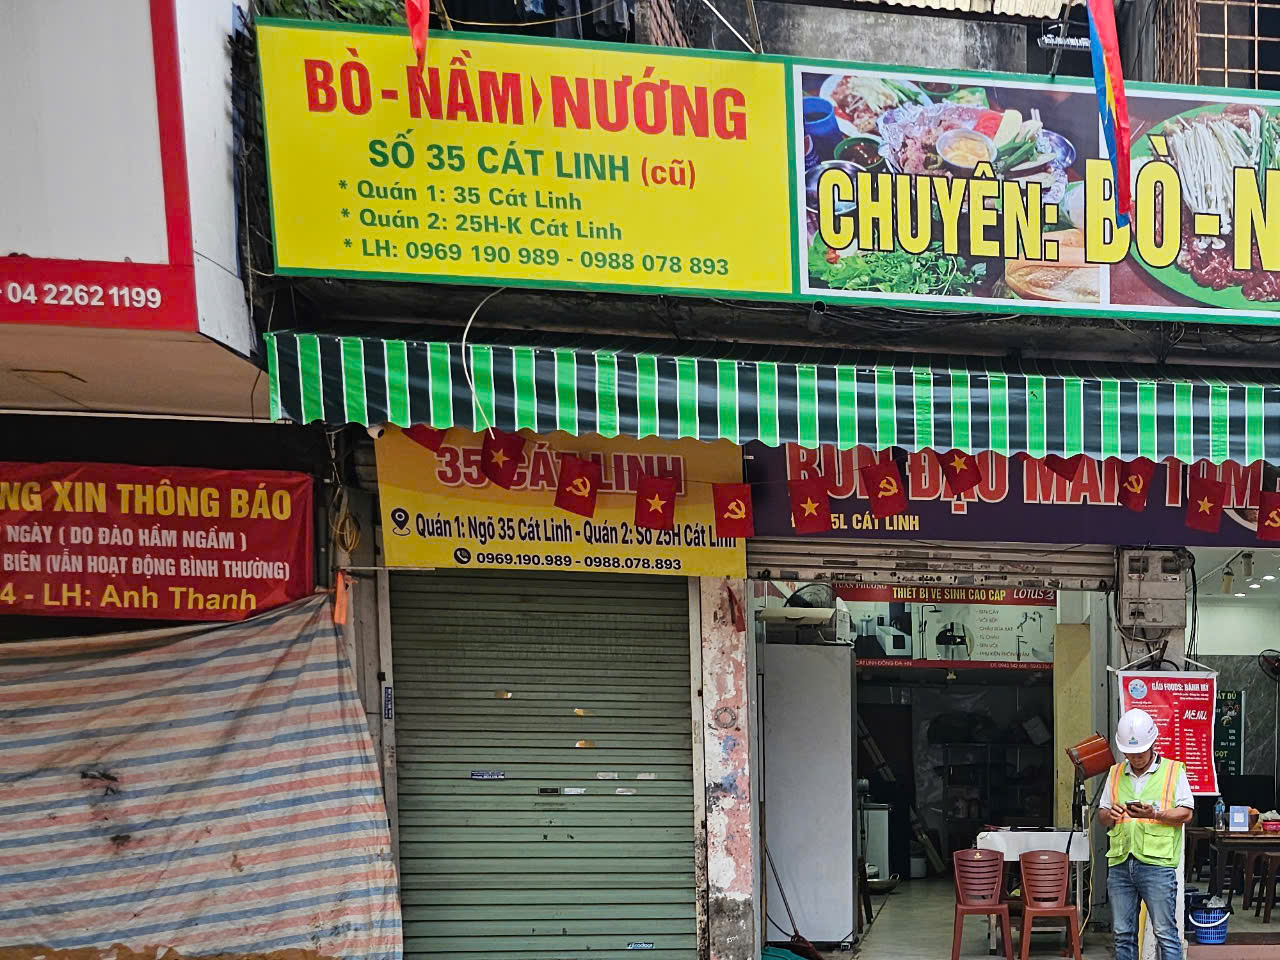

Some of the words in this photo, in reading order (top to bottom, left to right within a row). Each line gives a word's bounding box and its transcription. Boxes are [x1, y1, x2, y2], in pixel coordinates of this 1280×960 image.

[304, 47, 372, 115] BÒ
[406, 48, 524, 126] NẦM
[550, 66, 747, 140] NƯỚNG
[368, 128, 415, 169] SỐ
[426, 143, 466, 172] 35
[477, 140, 544, 177] CÁT
[555, 151, 629, 182] LINH
[641, 157, 696, 190] (cũ)
[357, 180, 417, 201] Quán
[426, 185, 445, 202] 1:
[453, 186, 481, 205] 35
[488, 187, 527, 208] Cát
[535, 190, 582, 210] Linh
[817, 160, 1060, 262] CHUYÊN:
[1083, 133, 1183, 269] BÒ
[359, 208, 420, 229] Quán
[427, 213, 448, 230] 2:
[455, 214, 522, 235] 25H-K
[530, 217, 568, 238] Cát
[576, 220, 622, 241] Linh
[361, 239, 398, 258] LH:
[405, 241, 462, 261] 0969
[472, 245, 511, 264] 190
[518, 247, 560, 266] 989
[580, 251, 635, 270] 0988
[642, 255, 683, 273] 078
[689, 257, 730, 276] 893
[7, 282, 38, 304] 04
[43, 283, 105, 306] 2262
[108, 286, 162, 309] 1199
[51, 481, 107, 513] XIN
[116, 478, 220, 518] THÔNG
[230, 483, 292, 520] BÁO
[6, 522, 53, 544] NGÀY
[70, 526, 93, 545] DO
[98, 524, 134, 546] ĐÀO
[138, 522, 178, 548] HẦM
[182, 525, 235, 550] NGẦM
[416, 512, 453, 538] Quán
[455, 515, 466, 538] 1:
[467, 516, 496, 545] Ngõ
[498, 517, 515, 541] 35
[518, 517, 542, 542] Cát
[544, 517, 573, 542] Linh
[584, 520, 618, 545] Quán
[620, 522, 633, 545] 2:
[684, 523, 706, 547] Cát
[885, 514, 920, 532] LINH
[3, 550, 41, 573] BIÊN
[46, 548, 83, 574] (VẪN
[87, 555, 128, 578] HOẠT
[132, 554, 176, 579] ĐỘNG
[180, 555, 219, 578] BÌNH
[222, 556, 290, 581] THƯỜNG)
[477, 552, 573, 567] 0969.190.989
[584, 556, 682, 570] 0988.078.893
[43, 583, 91, 607] LH:
[100, 584, 158, 609] Anh
[168, 586, 257, 610] Thanh
[944, 588, 966, 600] SINH
[968, 589, 986, 600] CAO
[1013, 588, 1044, 599] LOTUS
